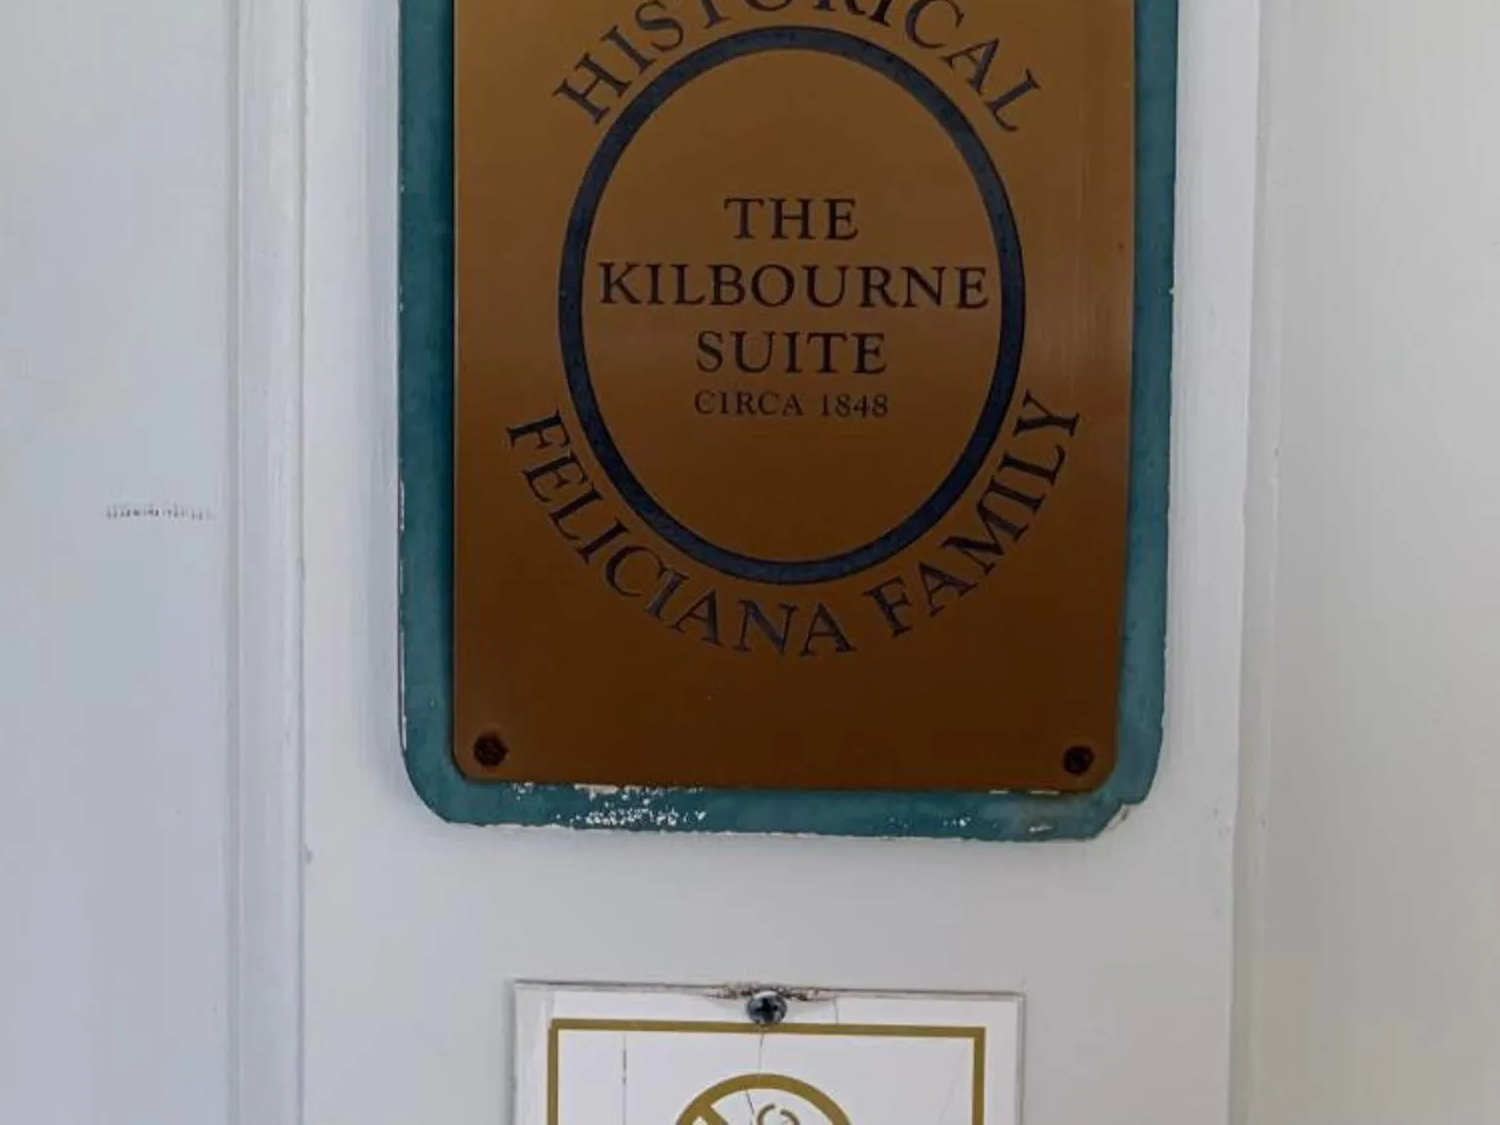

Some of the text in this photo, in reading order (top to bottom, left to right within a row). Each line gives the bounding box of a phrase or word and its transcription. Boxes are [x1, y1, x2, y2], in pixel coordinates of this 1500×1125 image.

[725, 197, 858, 241] THE
[599, 262, 989, 311] KILBOURNE
[696, 330, 887, 375] SUITE
[694, 390, 889, 420] CIRCA 1848
[506, 389, 1081, 657] FELICIANA FAMILY
